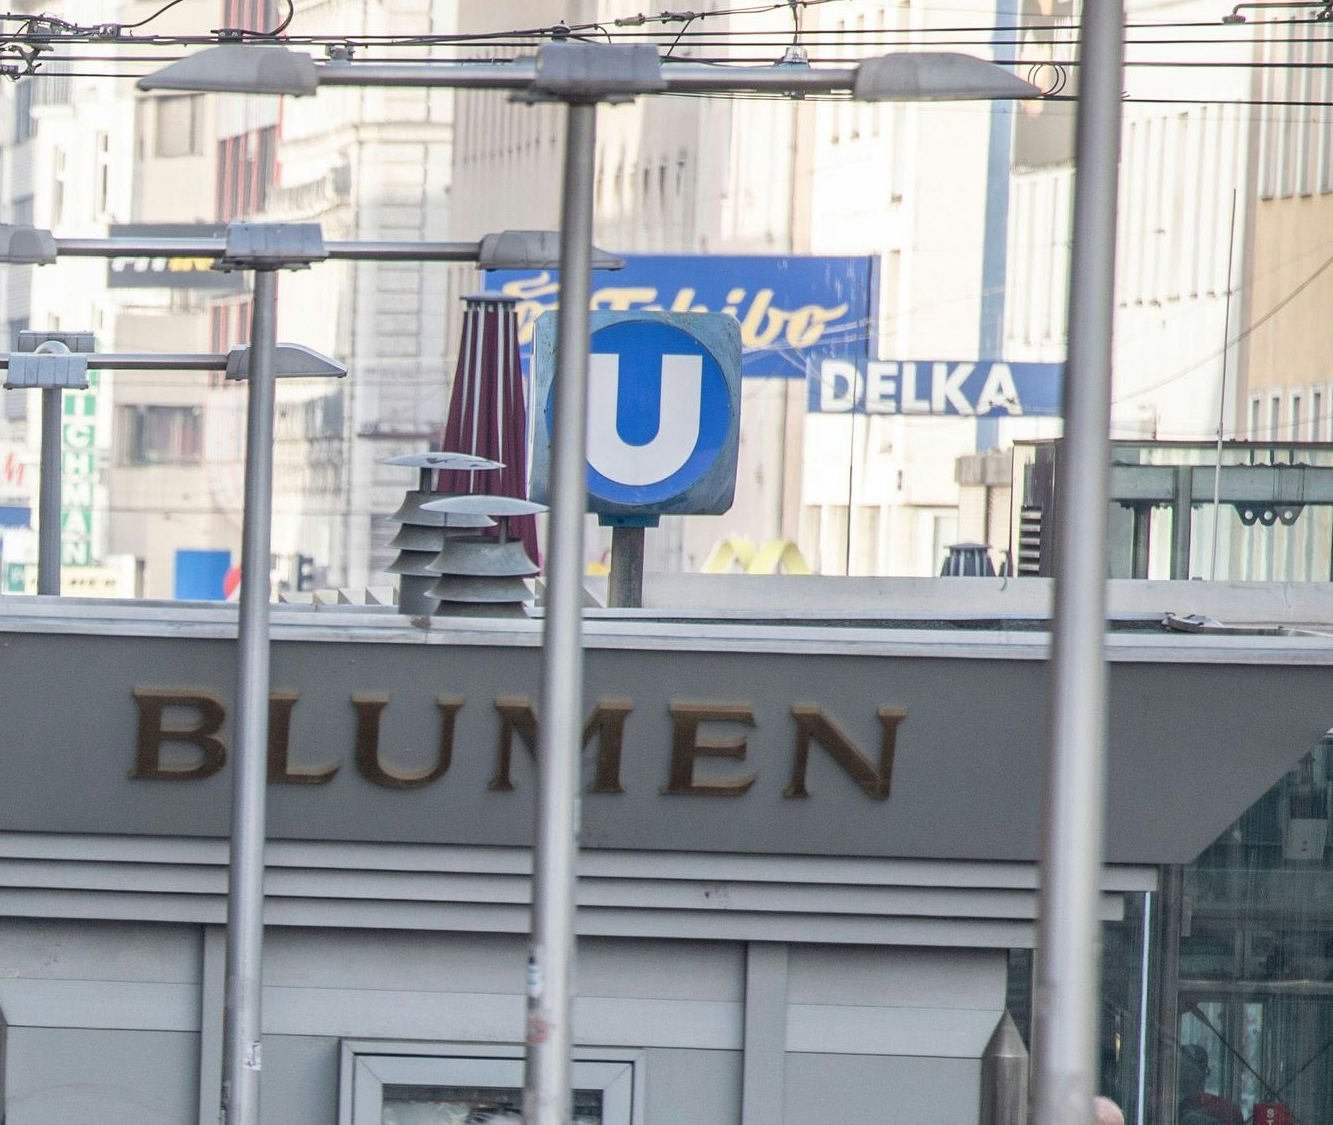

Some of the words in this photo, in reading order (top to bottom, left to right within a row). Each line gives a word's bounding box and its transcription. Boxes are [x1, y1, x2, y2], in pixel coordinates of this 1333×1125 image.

[585, 353, 704, 488] U
[820, 360, 1023, 417] DELKA
[128, 685, 907, 802] BLUMEN
